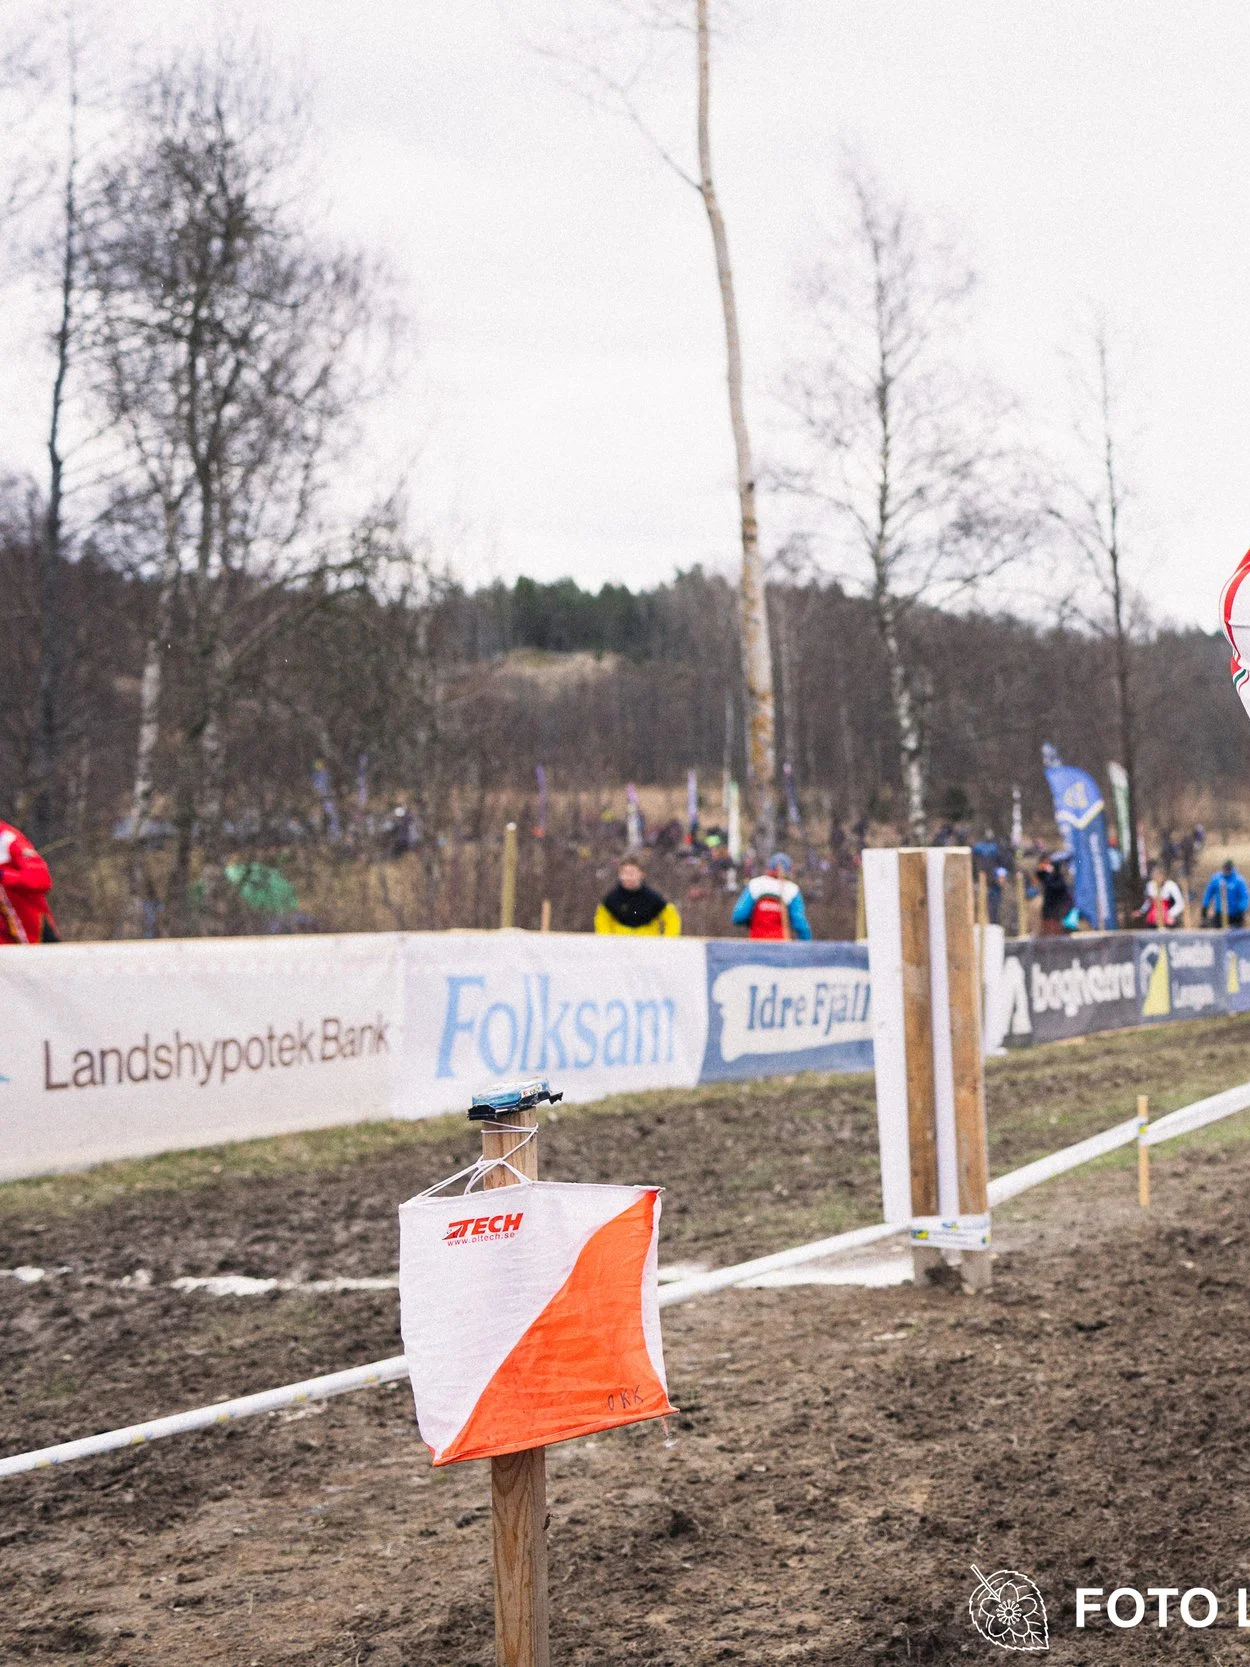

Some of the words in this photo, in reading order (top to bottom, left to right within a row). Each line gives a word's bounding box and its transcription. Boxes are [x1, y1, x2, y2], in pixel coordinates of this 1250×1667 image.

[435, 973, 676, 1079] Folksam
[747, 984, 807, 1031] Idre
[43, 1021, 316, 1090] Landshypotek
[319, 1010, 392, 1062] Bank
[446, 1231, 516, 1247] www.oltech.se
[607, 1385, 644, 1411] OKK
